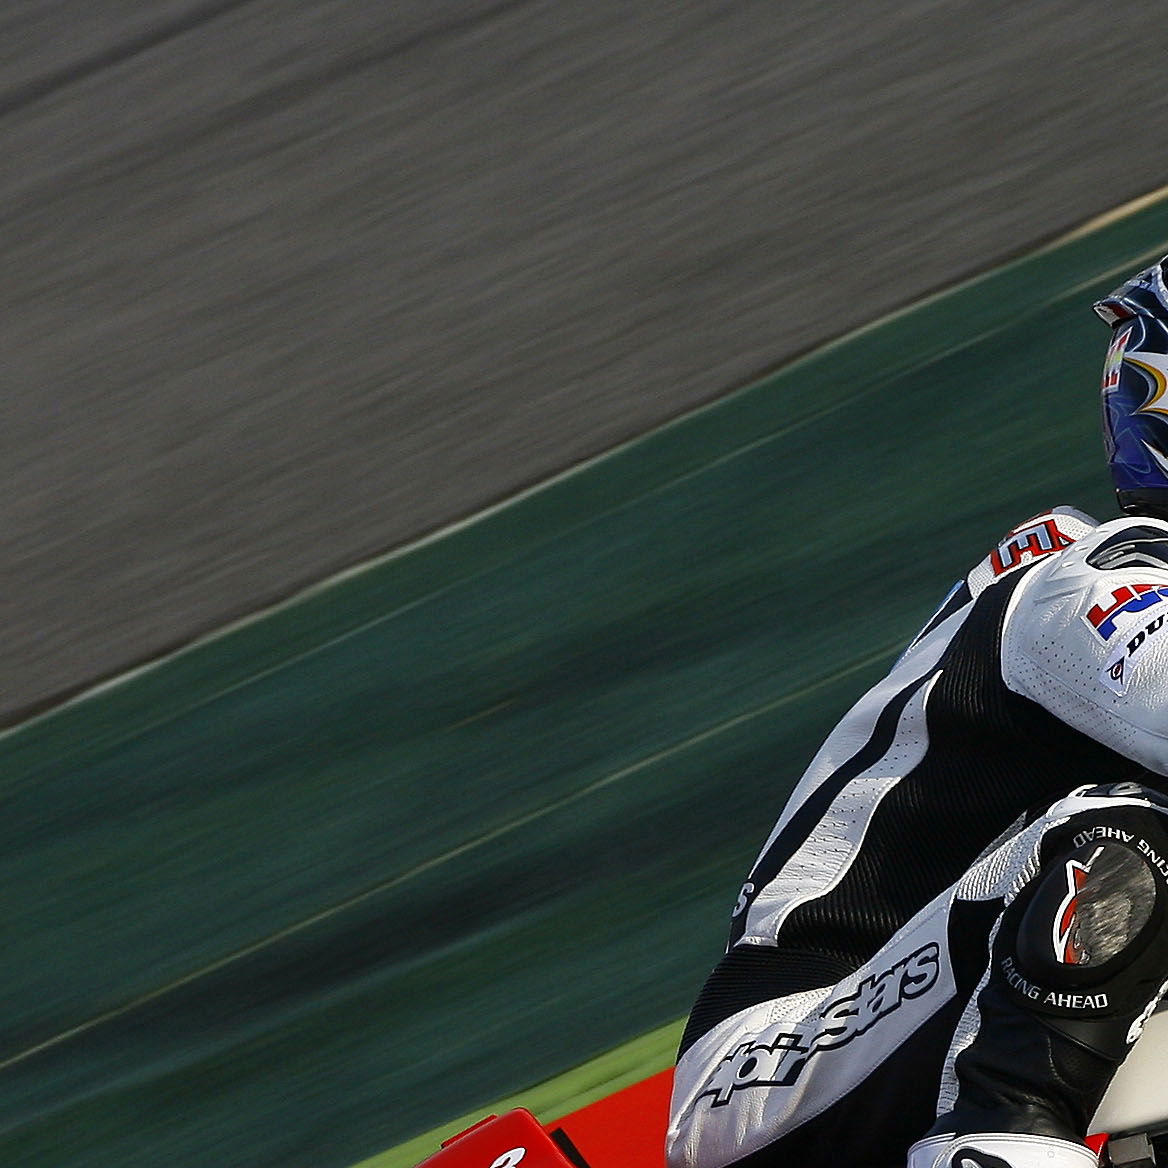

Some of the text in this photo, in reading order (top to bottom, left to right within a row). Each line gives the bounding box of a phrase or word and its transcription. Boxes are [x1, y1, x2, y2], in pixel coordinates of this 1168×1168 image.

[1073, 826, 1135, 849] AHEAD
[1001, 956, 1108, 1009] RACING AHEAD
